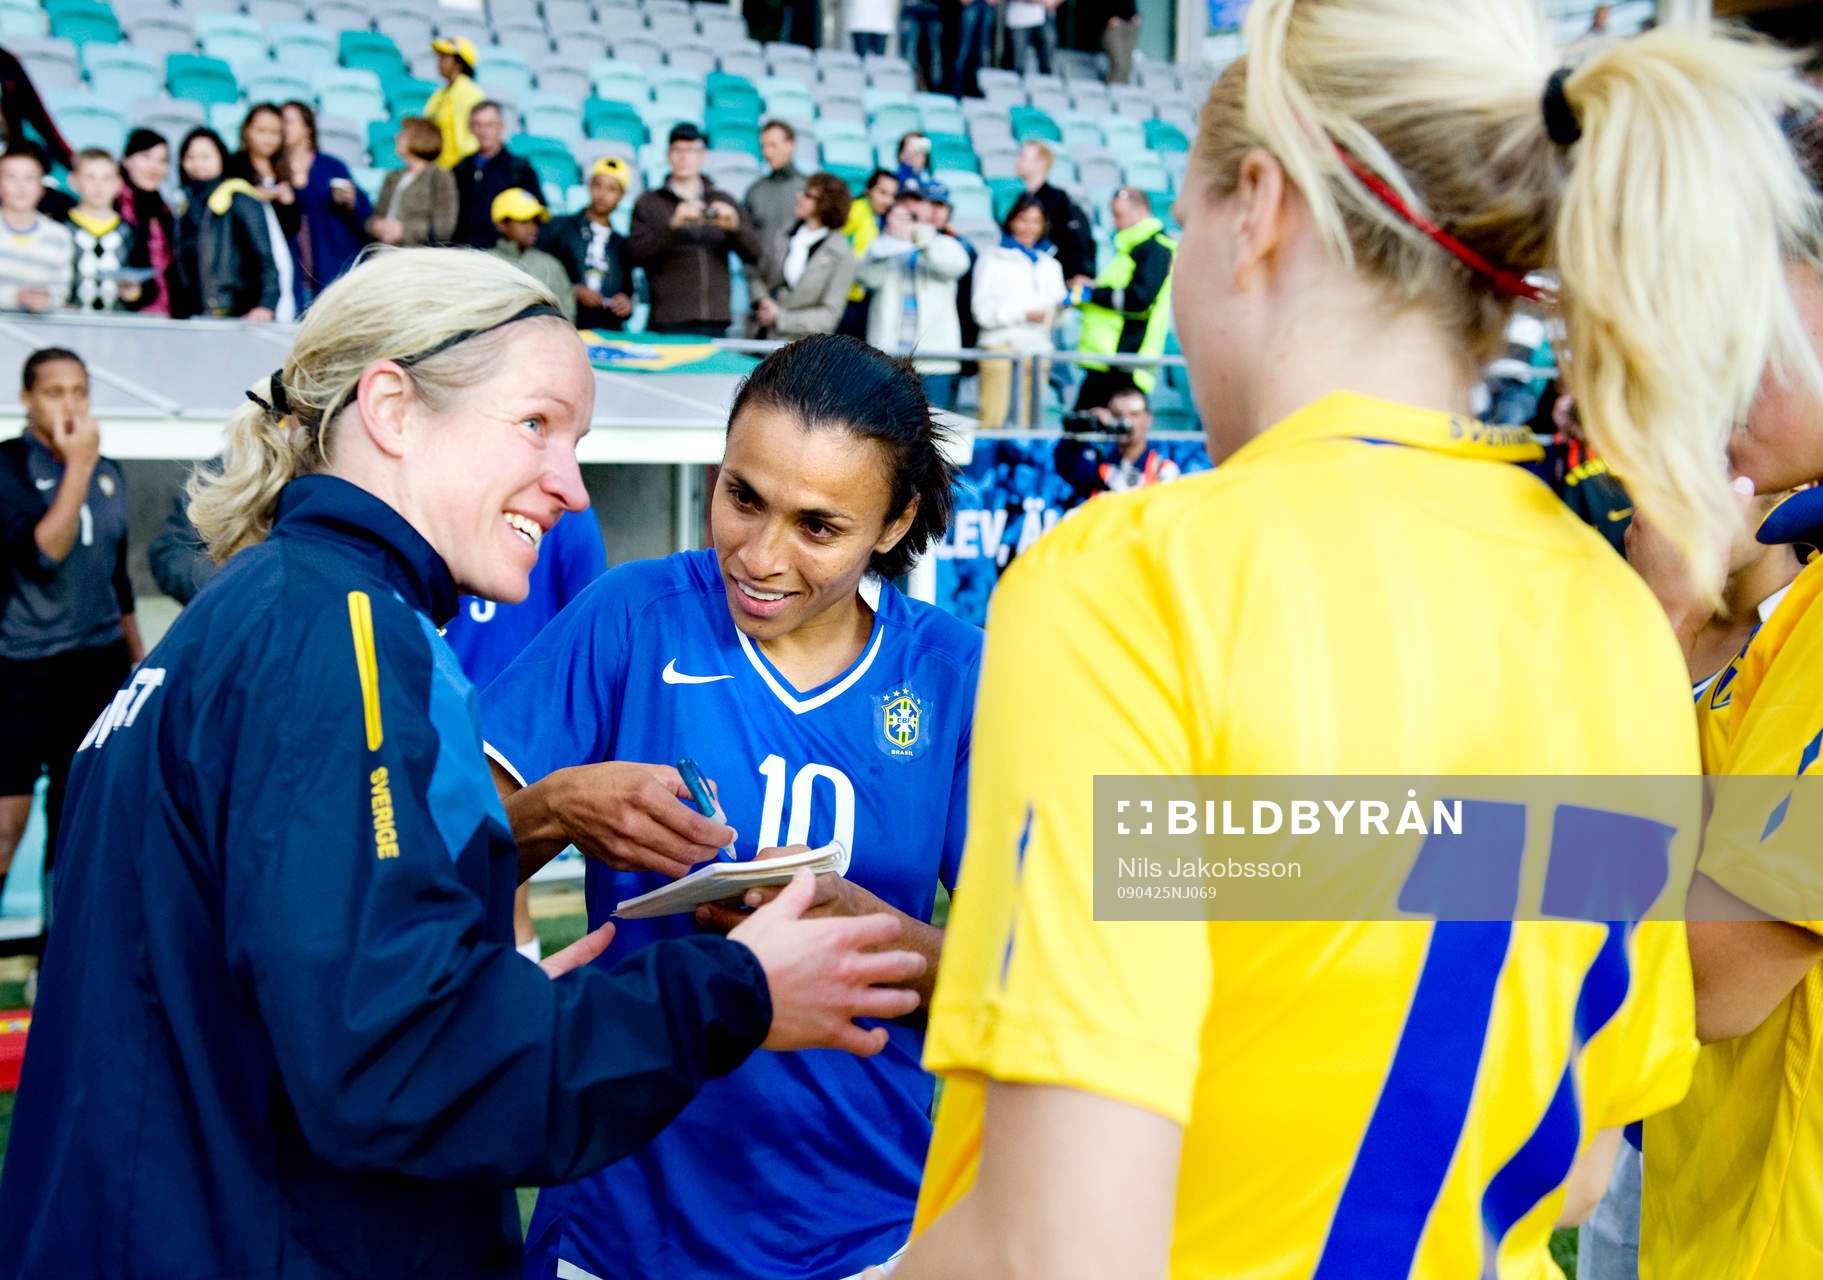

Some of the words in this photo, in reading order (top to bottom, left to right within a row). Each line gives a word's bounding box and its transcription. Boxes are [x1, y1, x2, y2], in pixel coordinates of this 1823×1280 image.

[890, 749, 914, 757] BRASIL
[370, 766, 400, 860] SVERIGE
[756, 753, 855, 878] 10
